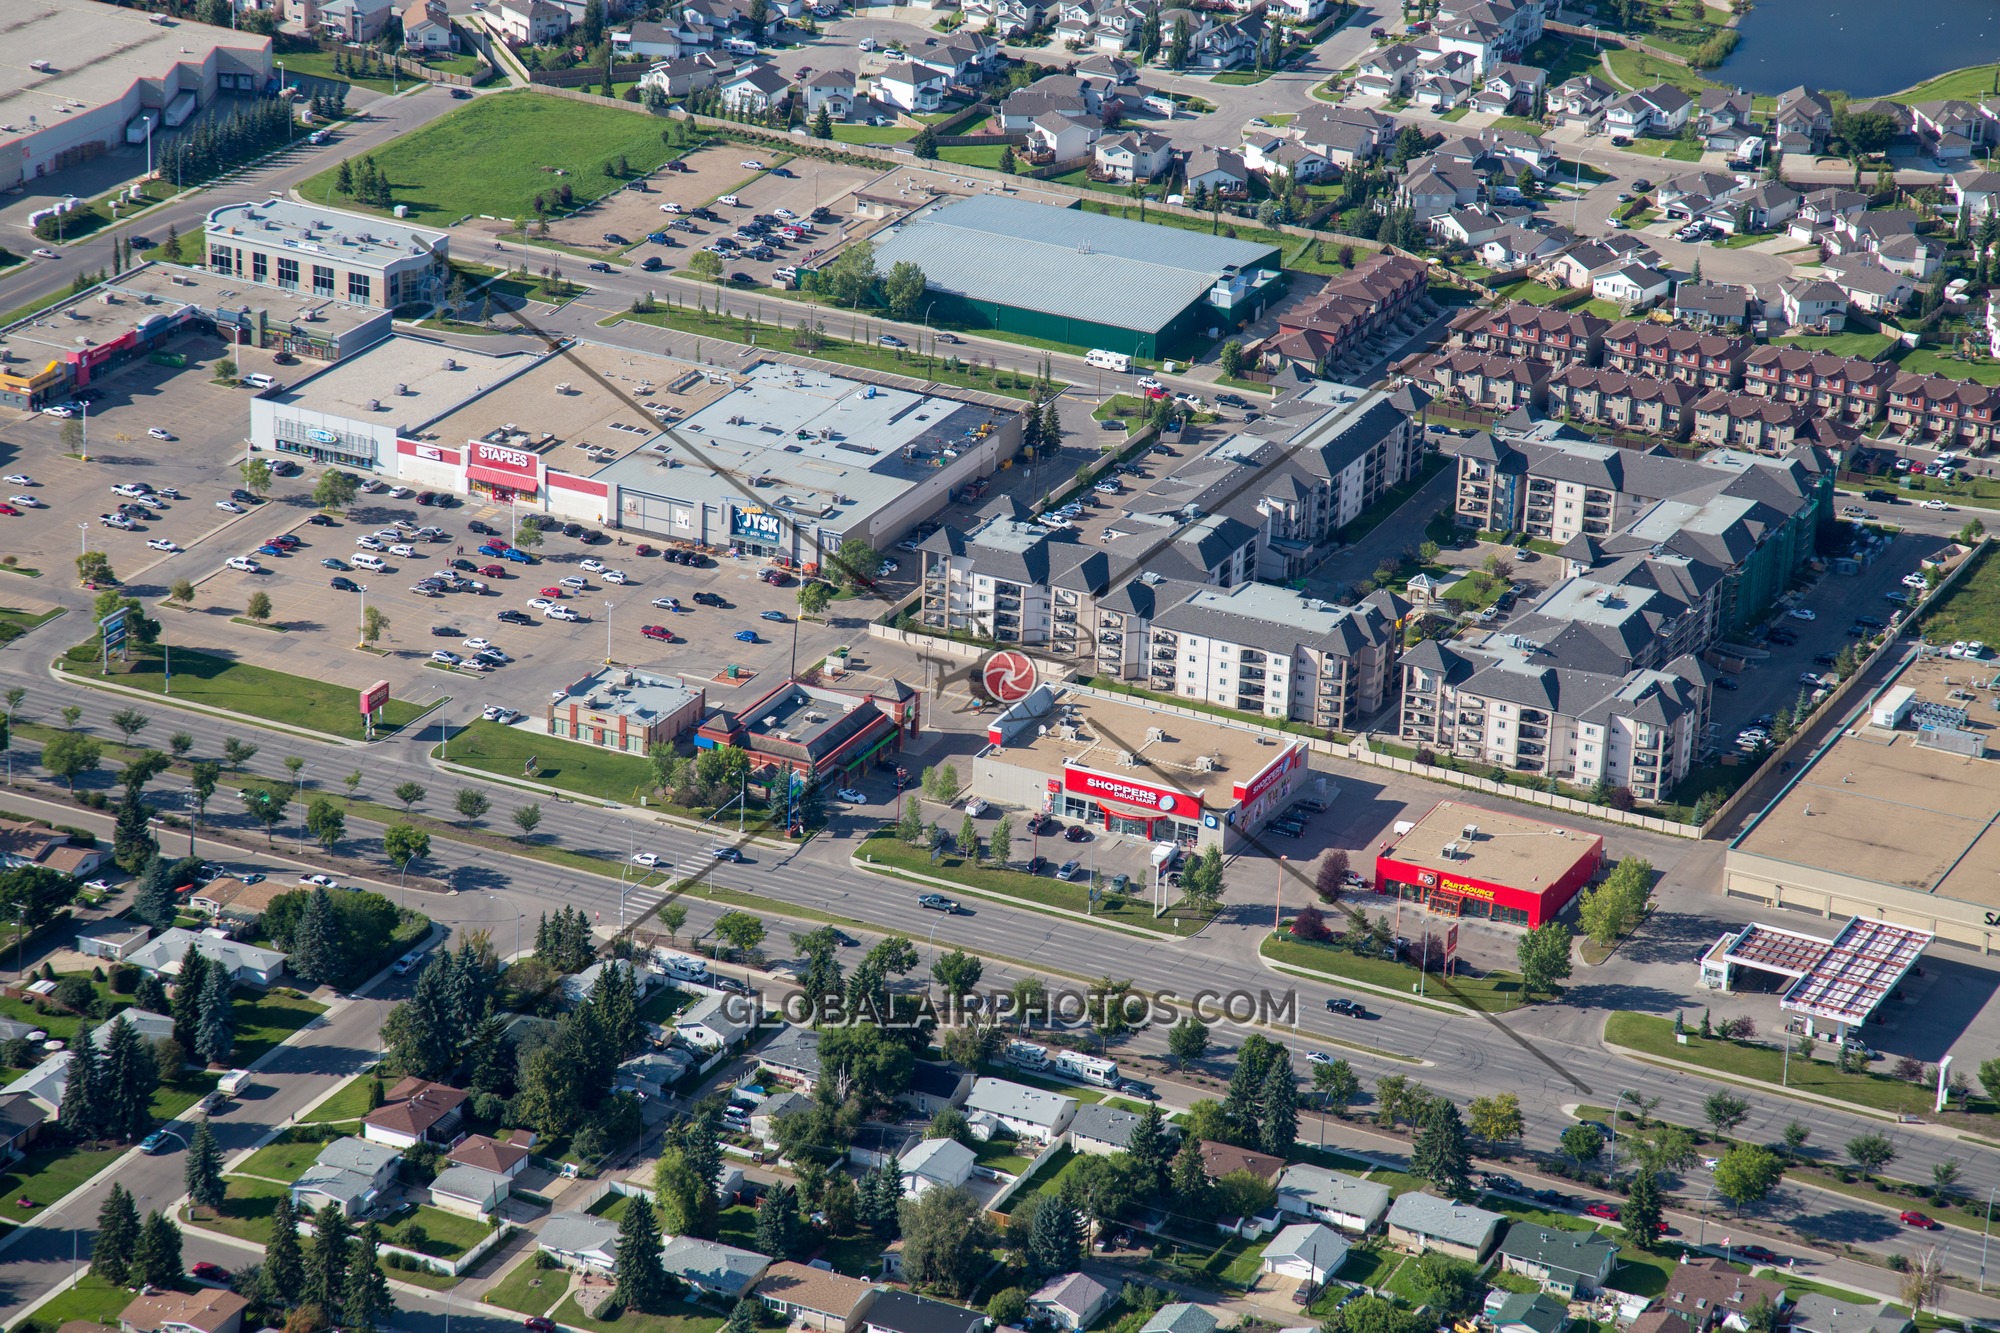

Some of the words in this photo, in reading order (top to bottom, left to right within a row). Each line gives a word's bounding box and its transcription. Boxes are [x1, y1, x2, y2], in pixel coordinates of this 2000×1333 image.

[479, 445, 528, 467] STAPLES
[743, 512, 779, 534] JYSK
[1087, 777, 1157, 801] SHOPPERS
[1114, 791, 1135, 802] DRUG
[1135, 796, 1157, 806] MART
